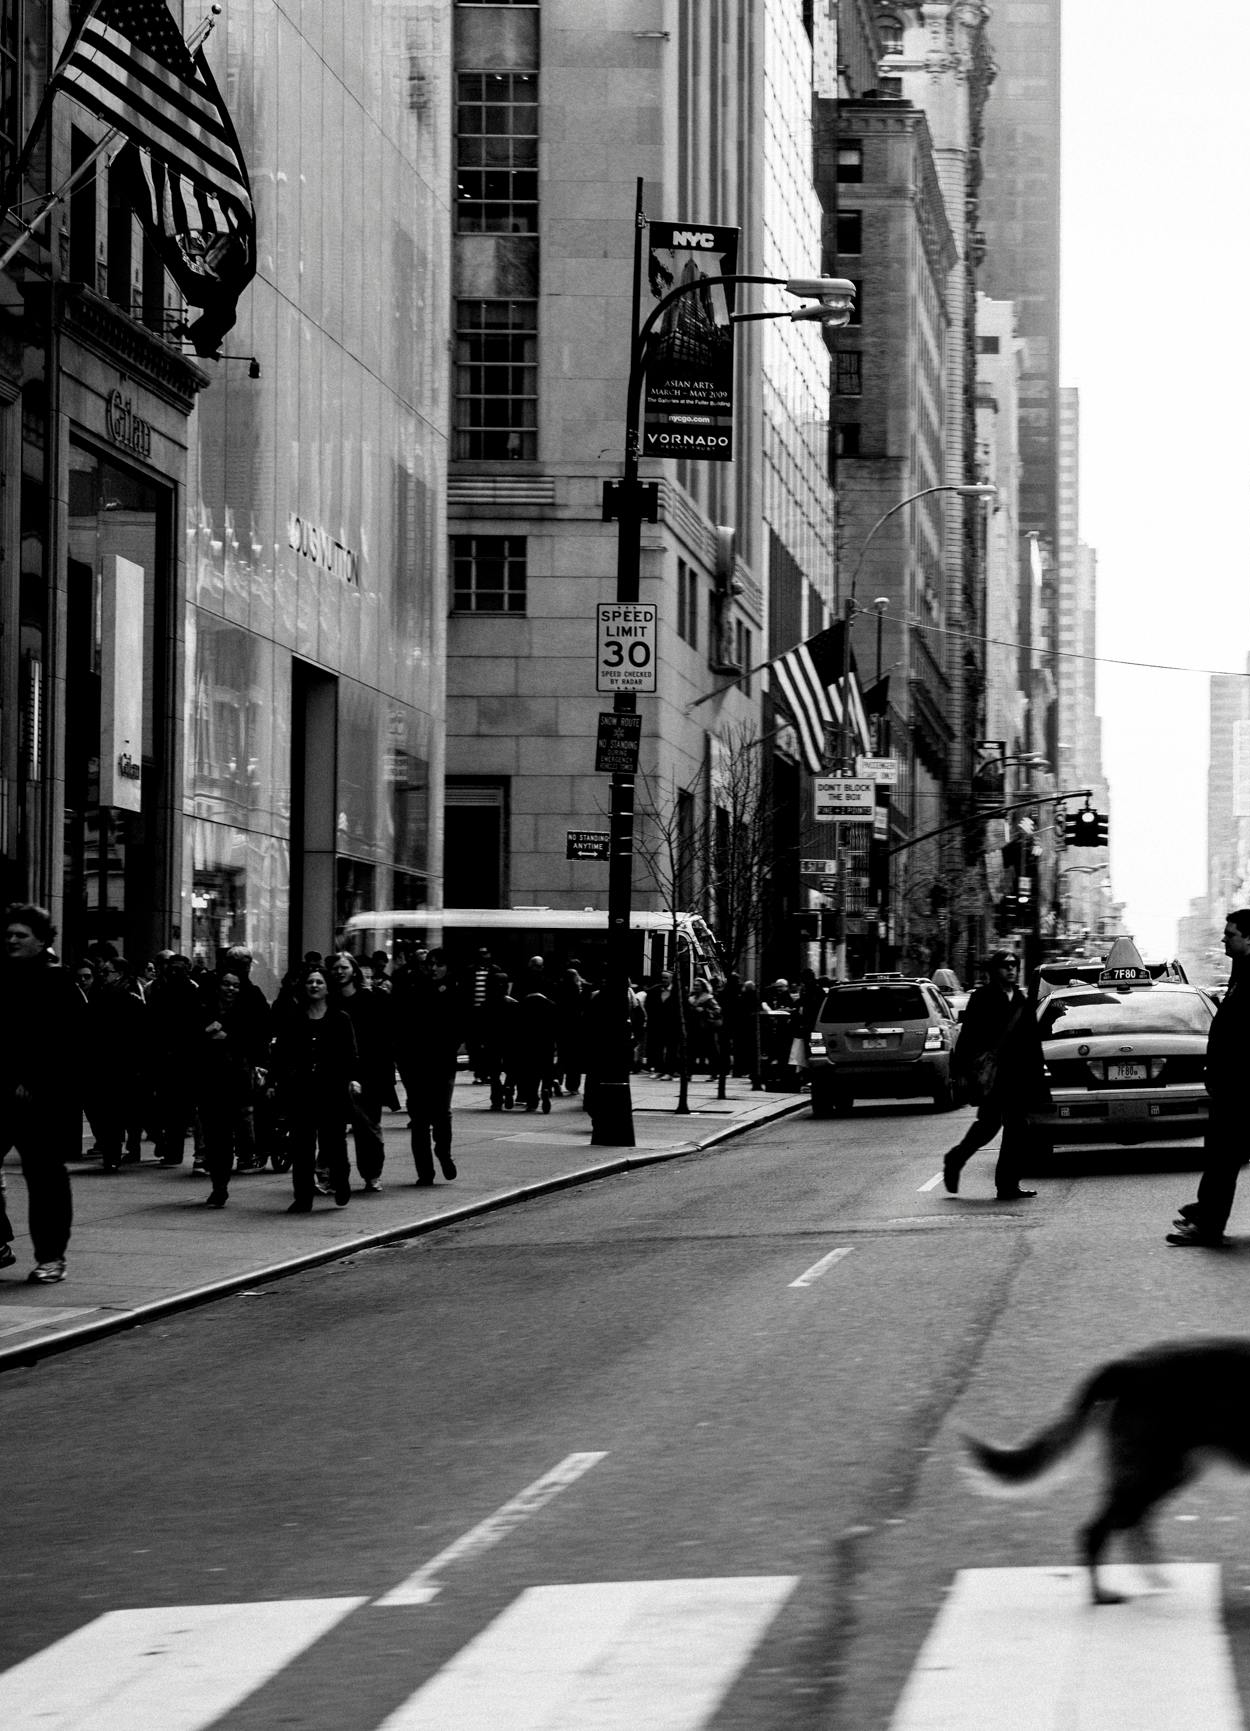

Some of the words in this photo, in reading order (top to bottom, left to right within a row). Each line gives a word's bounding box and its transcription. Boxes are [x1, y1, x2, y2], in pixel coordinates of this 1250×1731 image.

[673, 230, 715, 248] NYC
[664, 380, 691, 388] ASIAN
[693, 381, 714, 390] ARTS
[650, 388, 681, 396] MARCH
[689, 389, 708, 398] MAY
[708, 390, 728, 399] 2009
[668, 415, 710, 423] nycgo.com
[647, 433, 729, 447] VORNADO
[601, 610, 653, 622] SPEED
[606, 625, 648, 637] LIMIT
[602, 640, 651, 668] 30
[601, 670, 622, 678] SPEED
[817, 783, 842, 792] DON'T
[844, 783, 871, 792] BLOCK
[827, 793, 843, 801] THE
[568, 833, 577, 841] NO
[579, 834, 610, 842] STANDING
[572, 842, 604, 850] ANYTIME
[1113, 968, 1136, 979] 7F80
